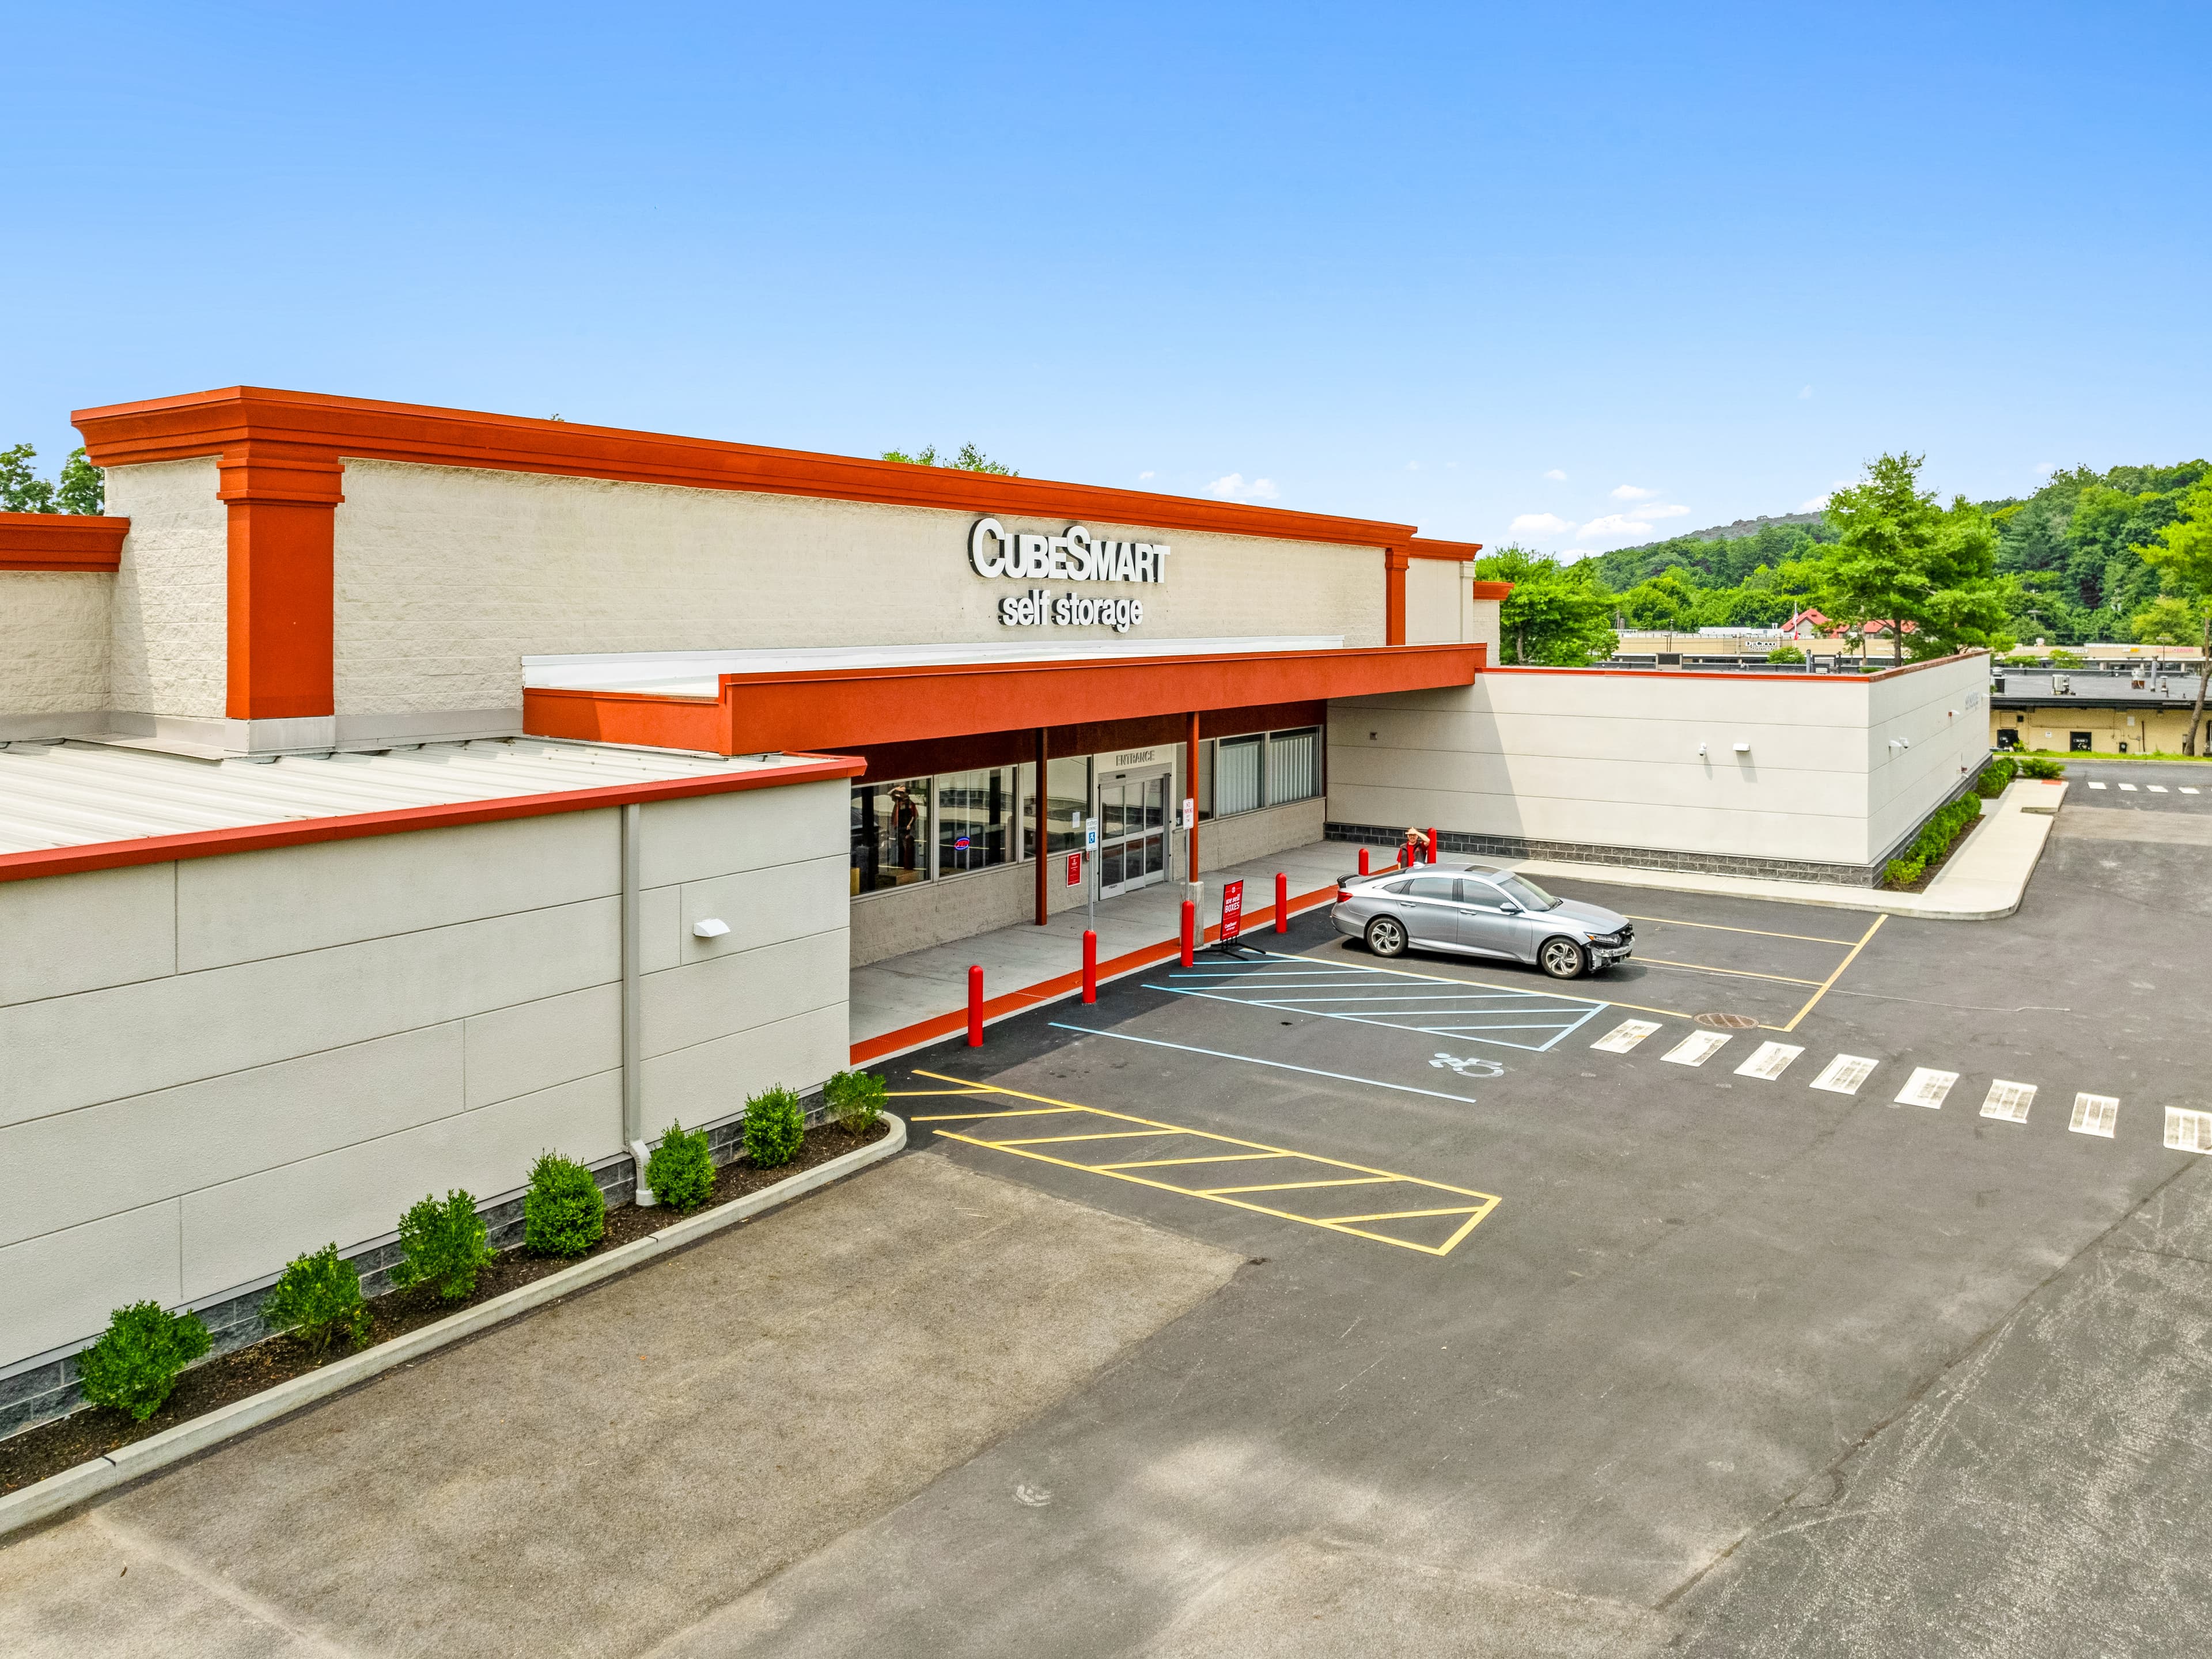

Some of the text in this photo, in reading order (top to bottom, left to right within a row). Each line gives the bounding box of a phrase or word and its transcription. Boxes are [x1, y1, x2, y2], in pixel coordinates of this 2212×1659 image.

[999, 589, 1143, 633] self storage
[1116, 750, 1155, 766] ENTRANCE
[1225, 902, 1240, 913] BOXES
